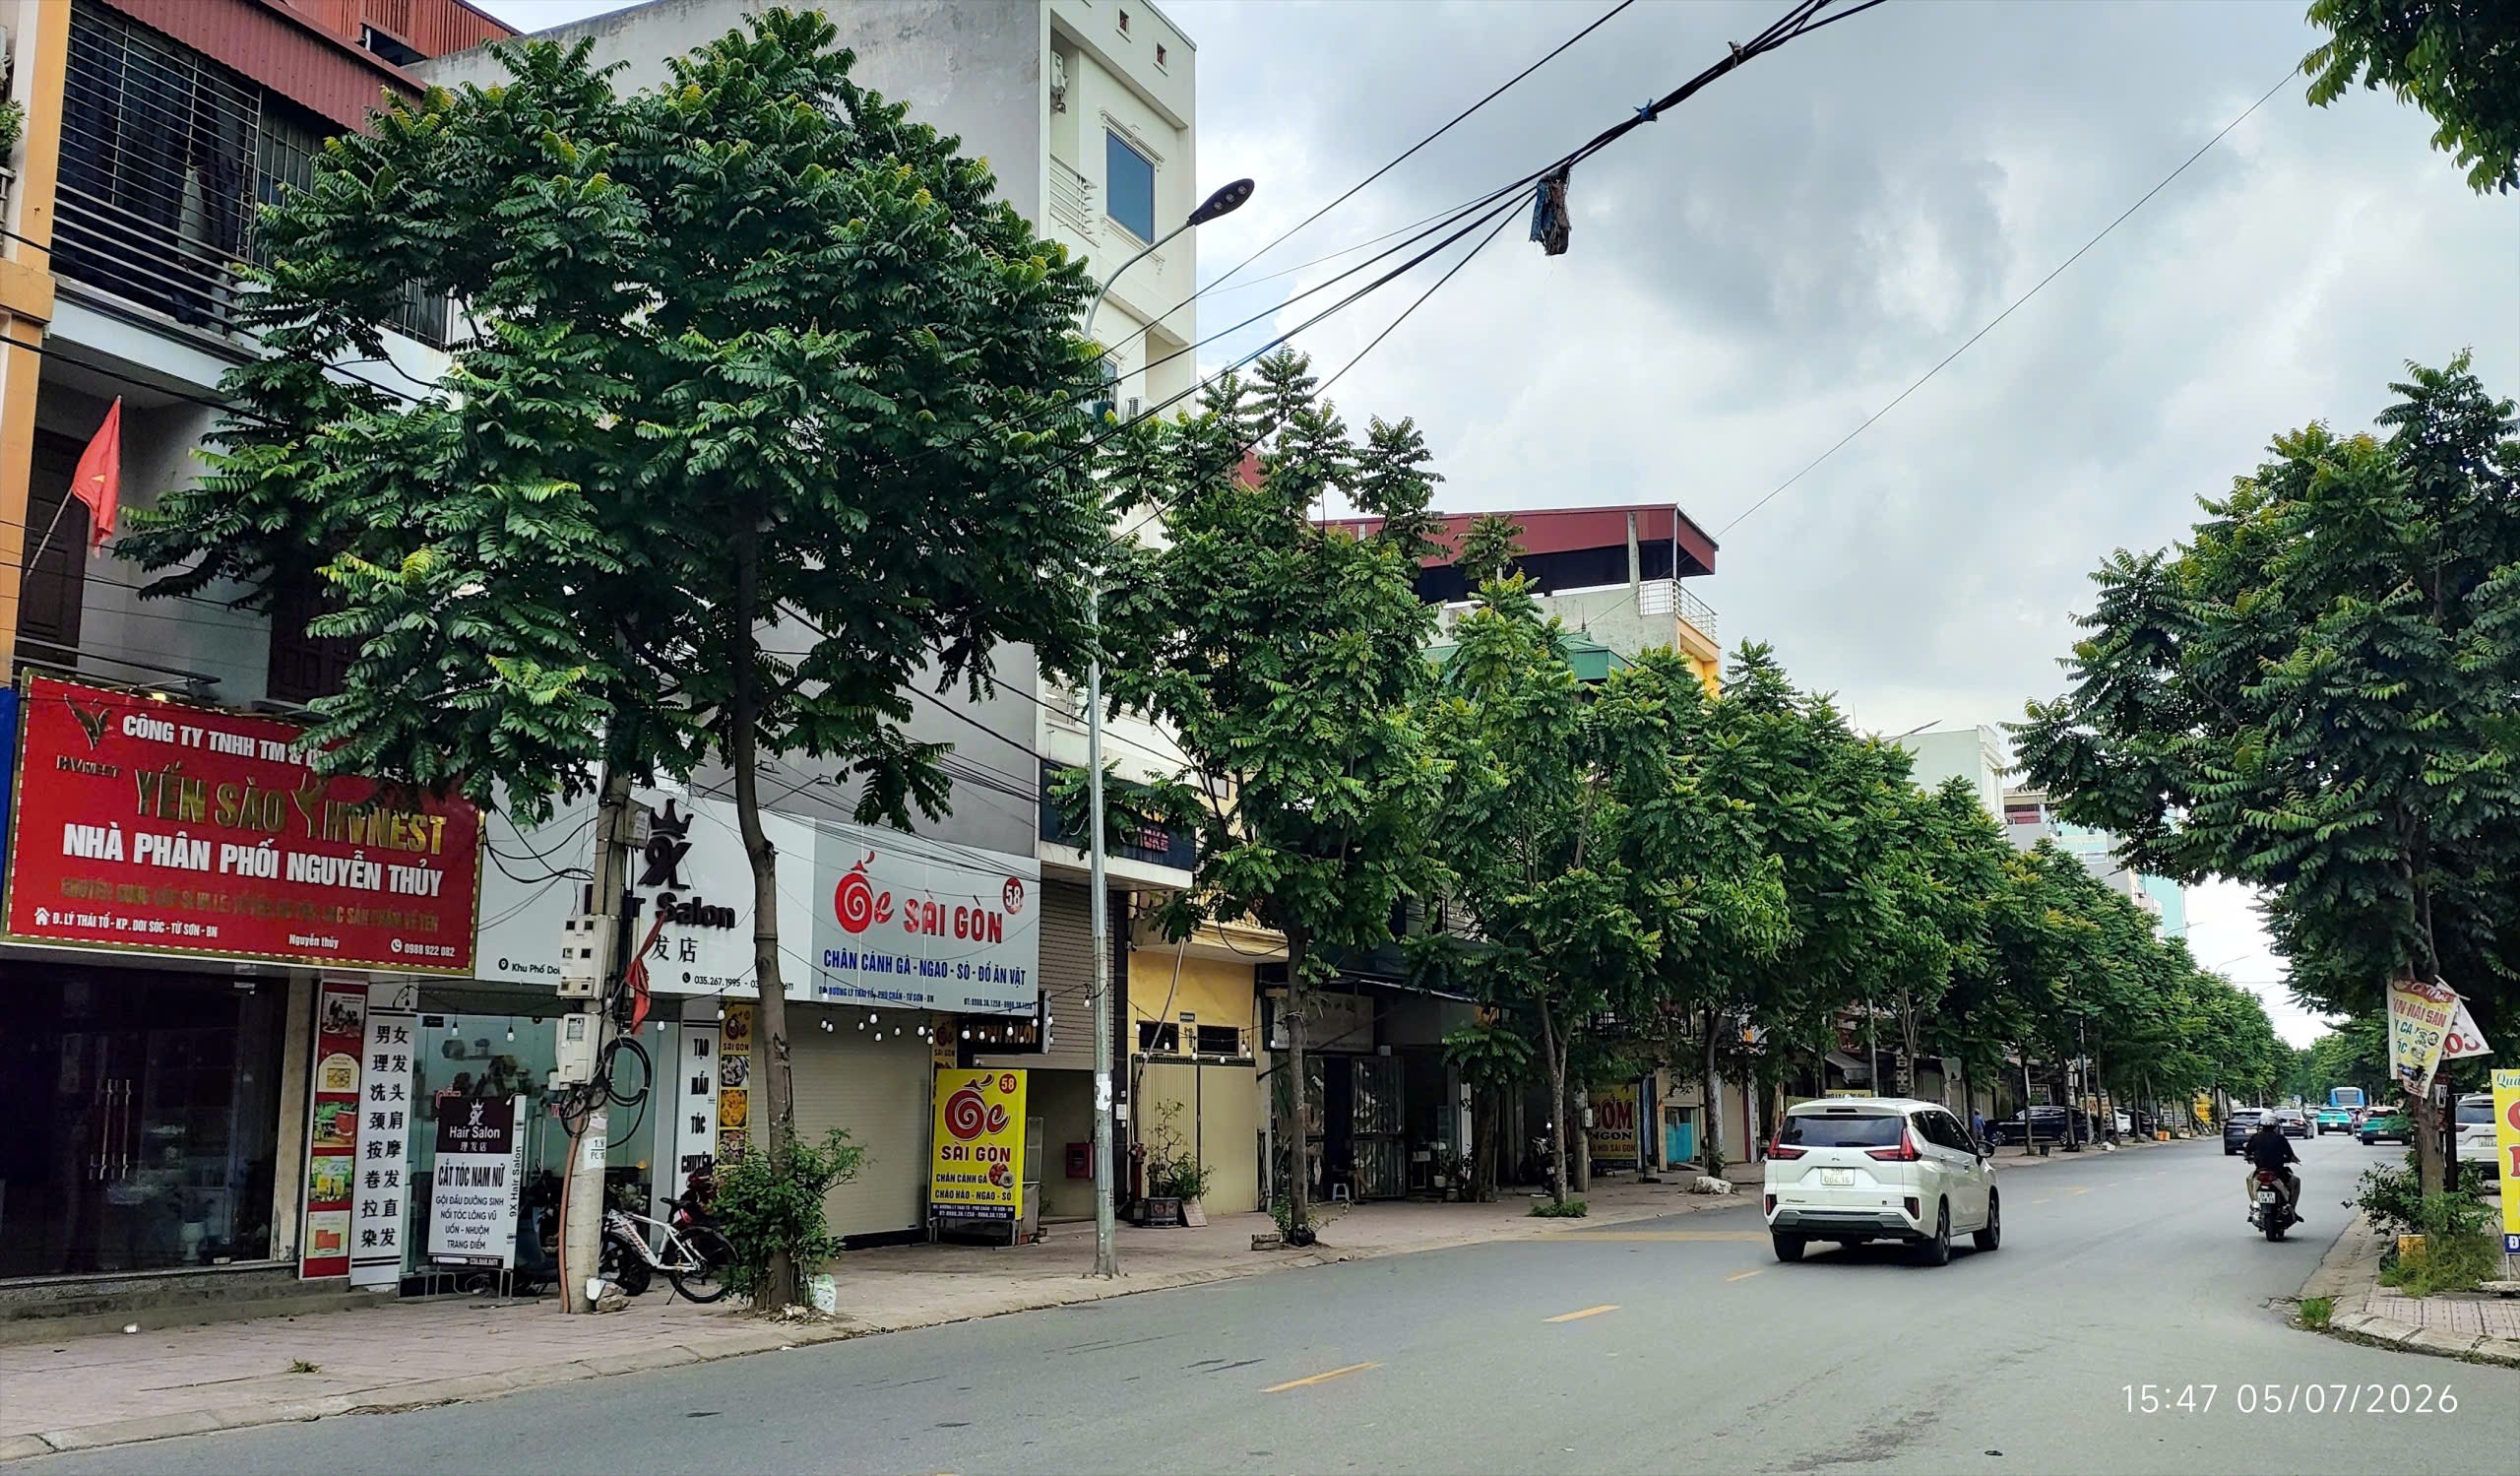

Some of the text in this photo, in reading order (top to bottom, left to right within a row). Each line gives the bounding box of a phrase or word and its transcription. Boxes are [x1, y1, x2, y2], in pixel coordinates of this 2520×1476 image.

[122, 713, 174, 743] CÔNG
[180, 725, 205, 748] TY
[209, 730, 255, 757] TNHH
[259, 739, 285, 763] TM
[135, 760, 206, 823] YẾN
[215, 775, 285, 833] SÀO
[63, 821, 443, 897] NHÀ PHÂN PHỐI NGUYỄN THỦY
[77, 912, 96, 928] THÁI
[656, 891, 735, 930] Salon
[903, 889, 1003, 944] SÀI GÒN
[512, 963, 528, 973] Khu
[530, 964, 545, 973] Phố
[823, 946, 857, 970] CHÂN
[861, 950, 892, 973] CÁNH
[896, 954, 912, 975] GÀ
[919, 959, 948, 979] NGAO
[957, 961, 970, 981] SÒ
[993, 964, 1007, 985] ĂN
[1009, 966, 1027, 989] VẶT
[2407, 1002, 2447, 1028] HẢI SẢN
[375, 1025, 410, 1044] 男女
[694, 1038, 710, 1060] TẠO
[371, 1055, 408, 1072] 理发
[370, 1083, 405, 1101] 洗头
[1000, 1077, 1015, 1091] 58
[369, 1111, 403, 1130] 颈肩
[691, 1113, 706, 1134] TÓC
[449, 1125, 470, 1138] Hair
[472, 1125, 500, 1139] Salon
[366, 1139, 402, 1160] 按摩
[941, 1141, 1011, 1163] SÀI GÒN
[512, 1145, 522, 1180] Salon
[364, 1170, 400, 1188] 卷发
[455, 1162, 470, 1187] TÓC
[472, 1165, 490, 1187] NAM
[489, 1196, 504, 1206] SINH
[511, 1182, 520, 1202] Hair
[361, 1198, 398, 1219] 拉直
[361, 1228, 396, 1248] 染发
[447, 1239, 469, 1249] TRANG
